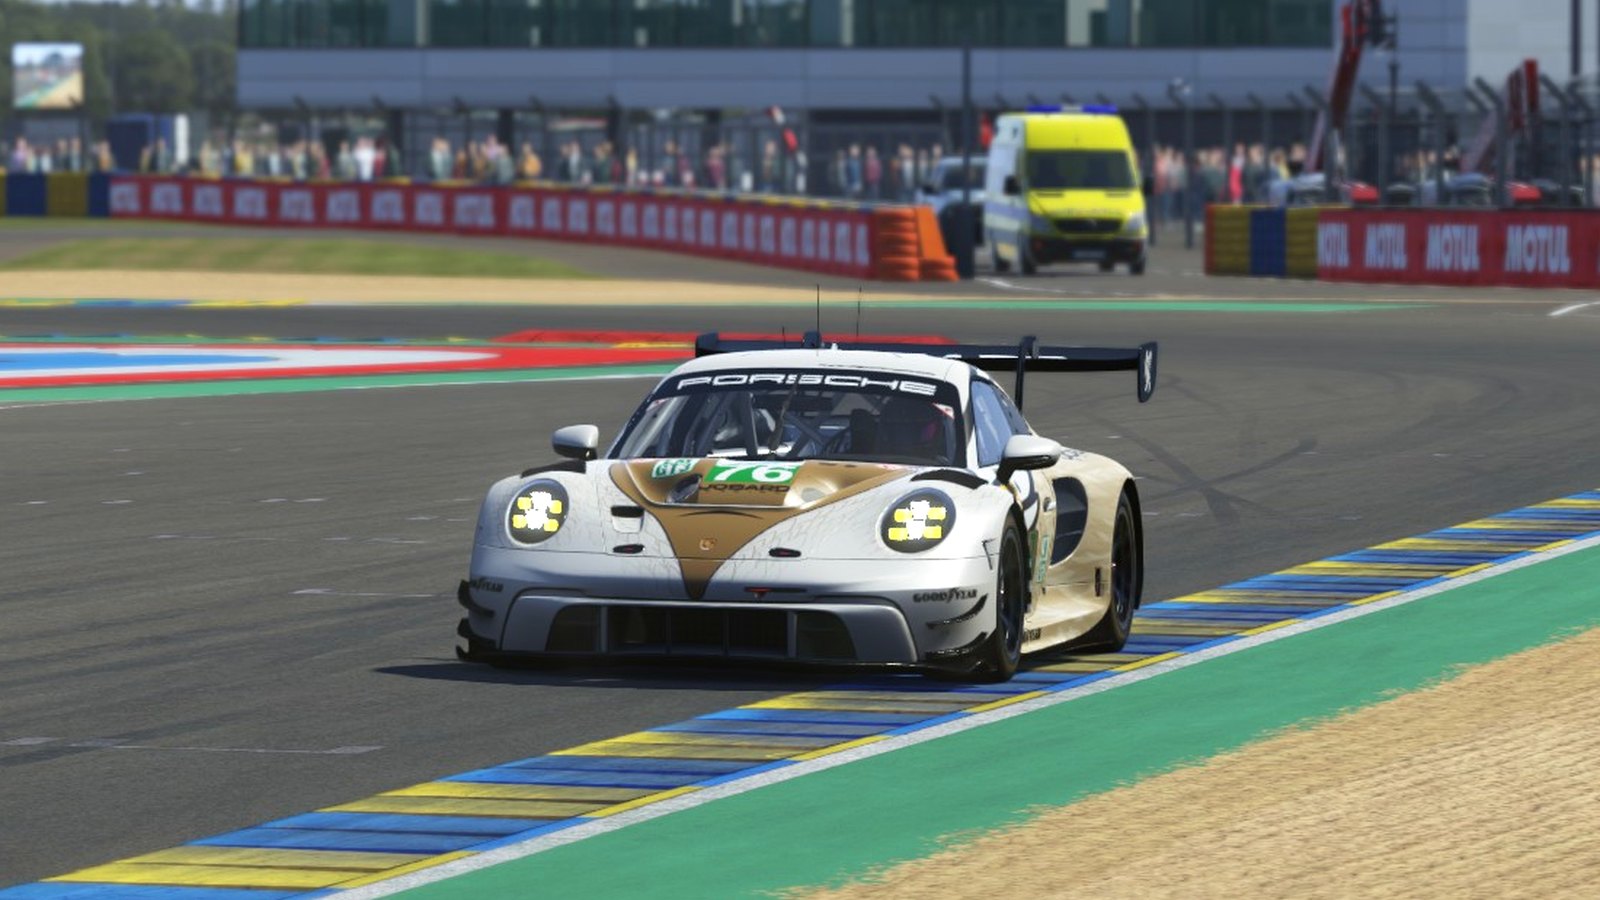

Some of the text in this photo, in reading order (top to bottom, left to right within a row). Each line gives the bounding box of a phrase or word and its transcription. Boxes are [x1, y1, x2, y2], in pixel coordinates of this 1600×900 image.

[1364, 223, 1408, 270] MOTUL
[1425, 224, 1480, 272] MOTUL
[1504, 224, 1571, 274] MOTUL
[677, 373, 938, 396] PORSCHE
[709, 464, 796, 483] 76
[912, 587, 978, 604] GOODYEAR
